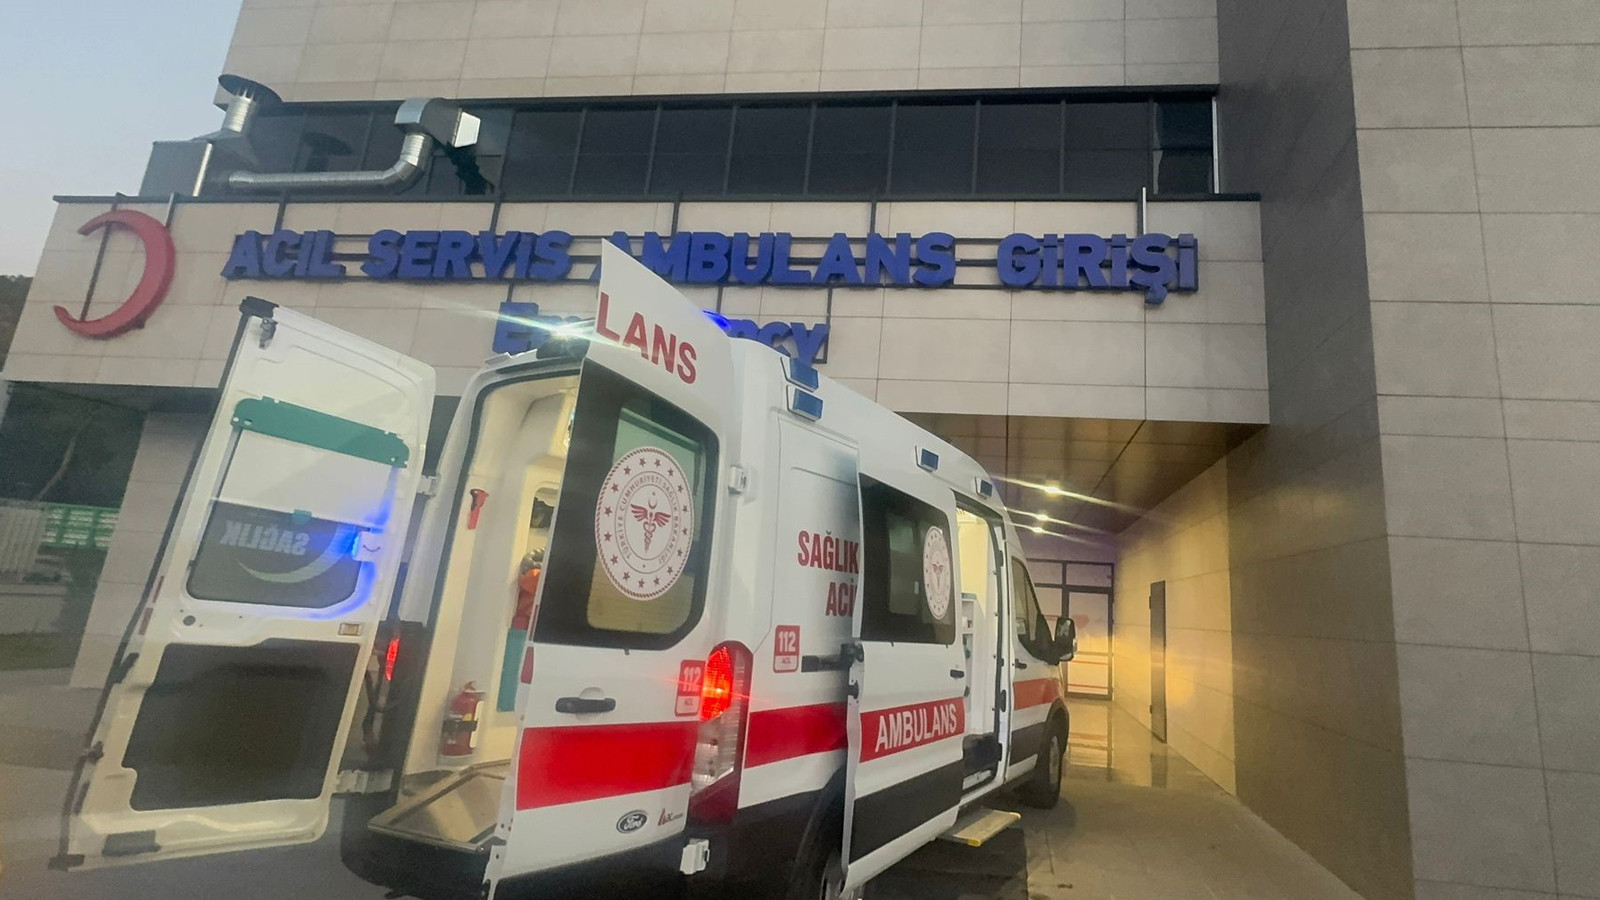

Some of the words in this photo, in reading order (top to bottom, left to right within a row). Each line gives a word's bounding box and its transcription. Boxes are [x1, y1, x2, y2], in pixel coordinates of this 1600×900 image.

[797, 529, 860, 575] SAĞLIK
[779, 631, 796, 652] 112
[683, 667, 702, 692] 112
[874, 703, 957, 753] AMBULANS
